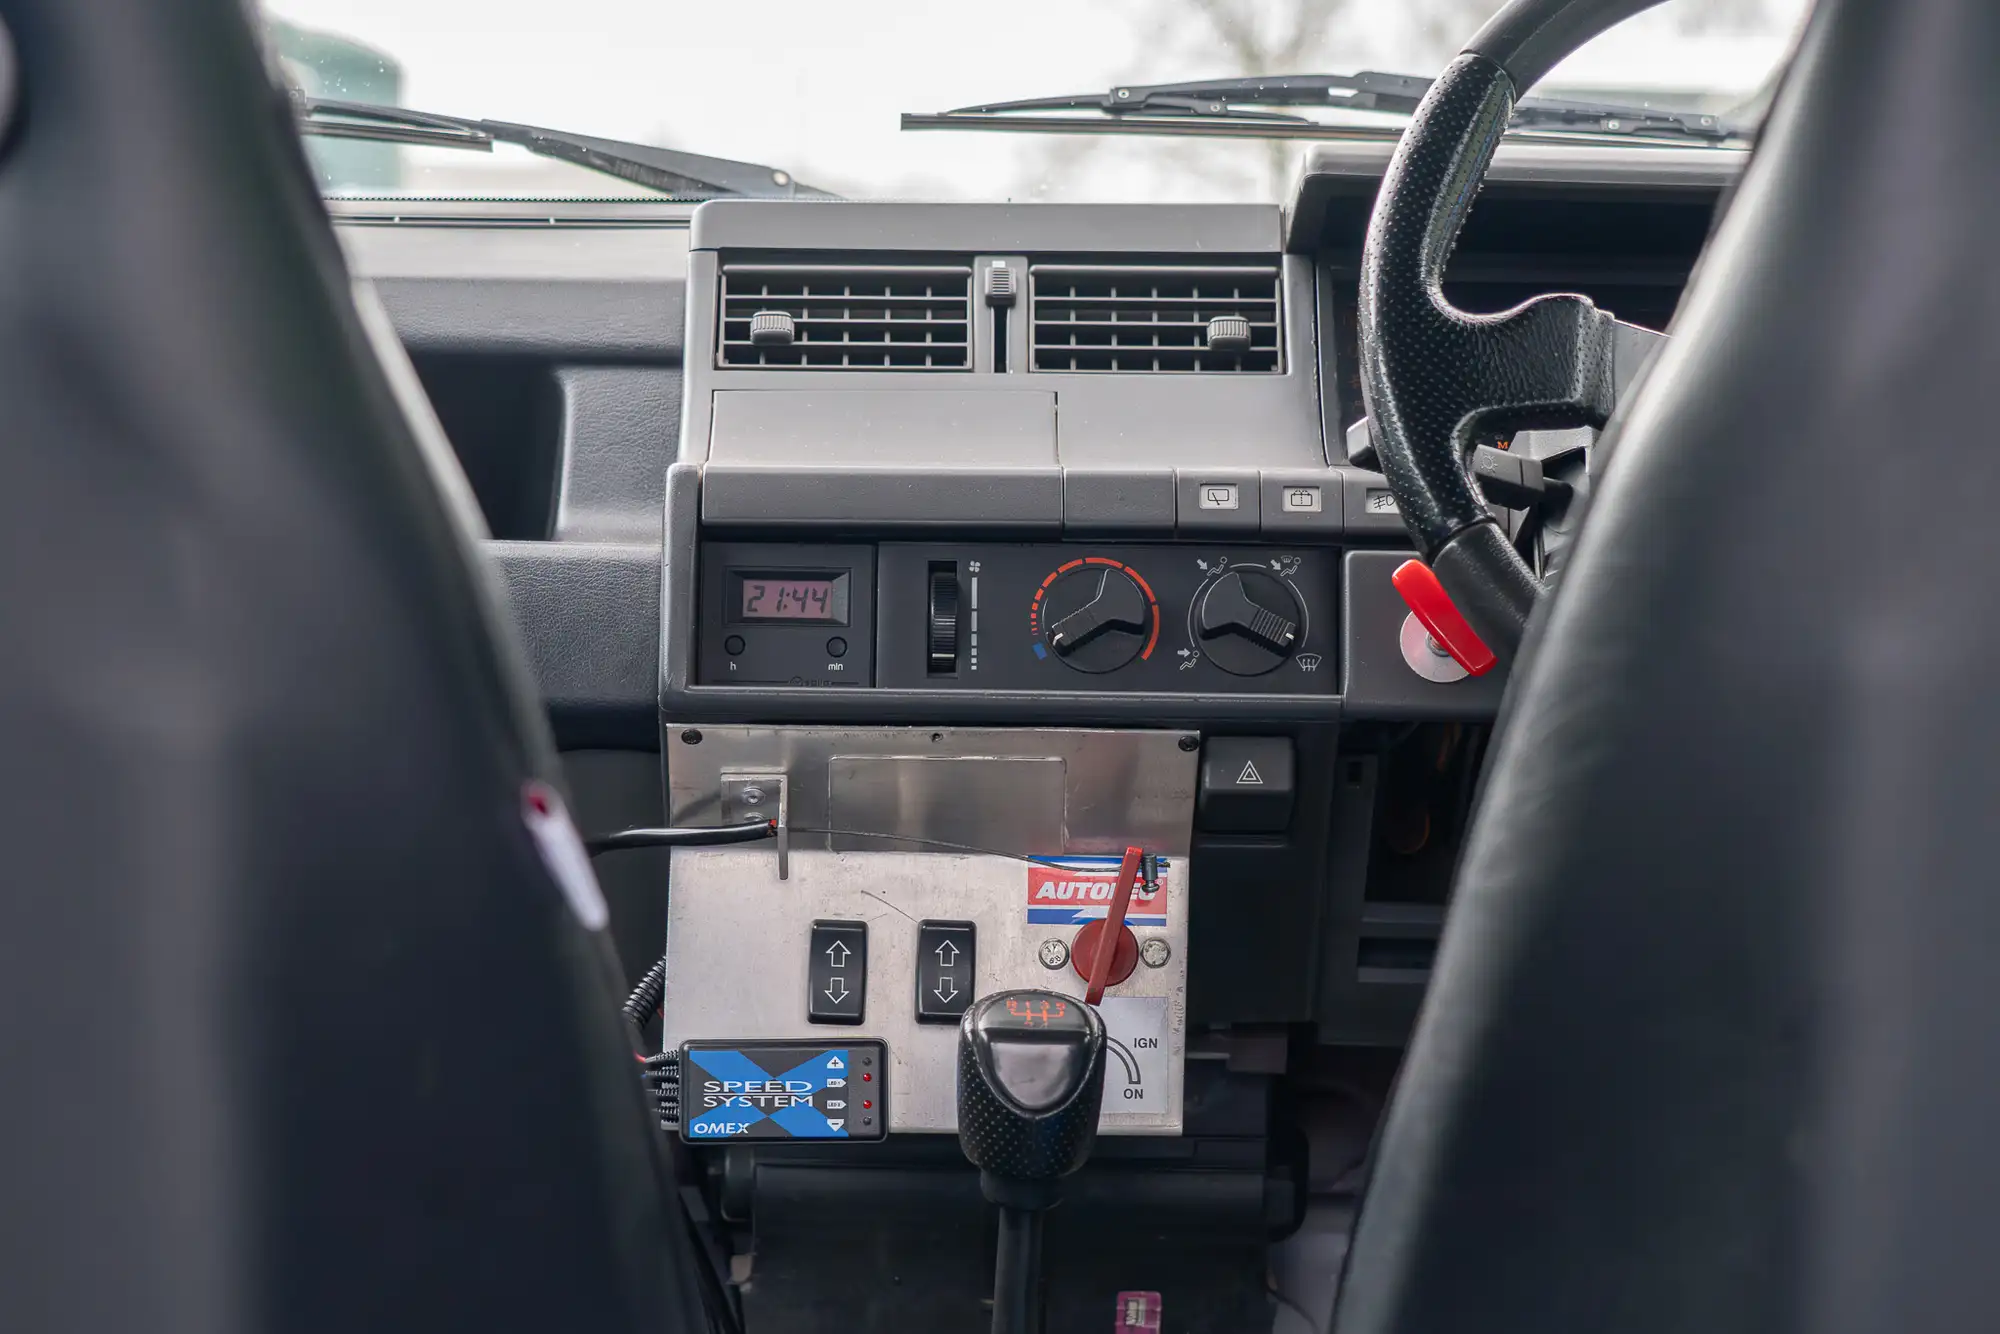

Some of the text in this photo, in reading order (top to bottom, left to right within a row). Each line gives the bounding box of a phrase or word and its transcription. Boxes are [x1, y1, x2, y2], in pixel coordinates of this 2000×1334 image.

[746, 584, 829, 614] 21:44
[730, 661, 737, 671] h
[828, 662, 844, 671] min
[1133, 1037, 1158, 1049] IGN
[703, 1080, 813, 1093] SPEED
[1123, 1088, 1144, 1099] ON
[703, 1095, 814, 1108] SYSTEM
[694, 1122, 751, 1134] OMEX
